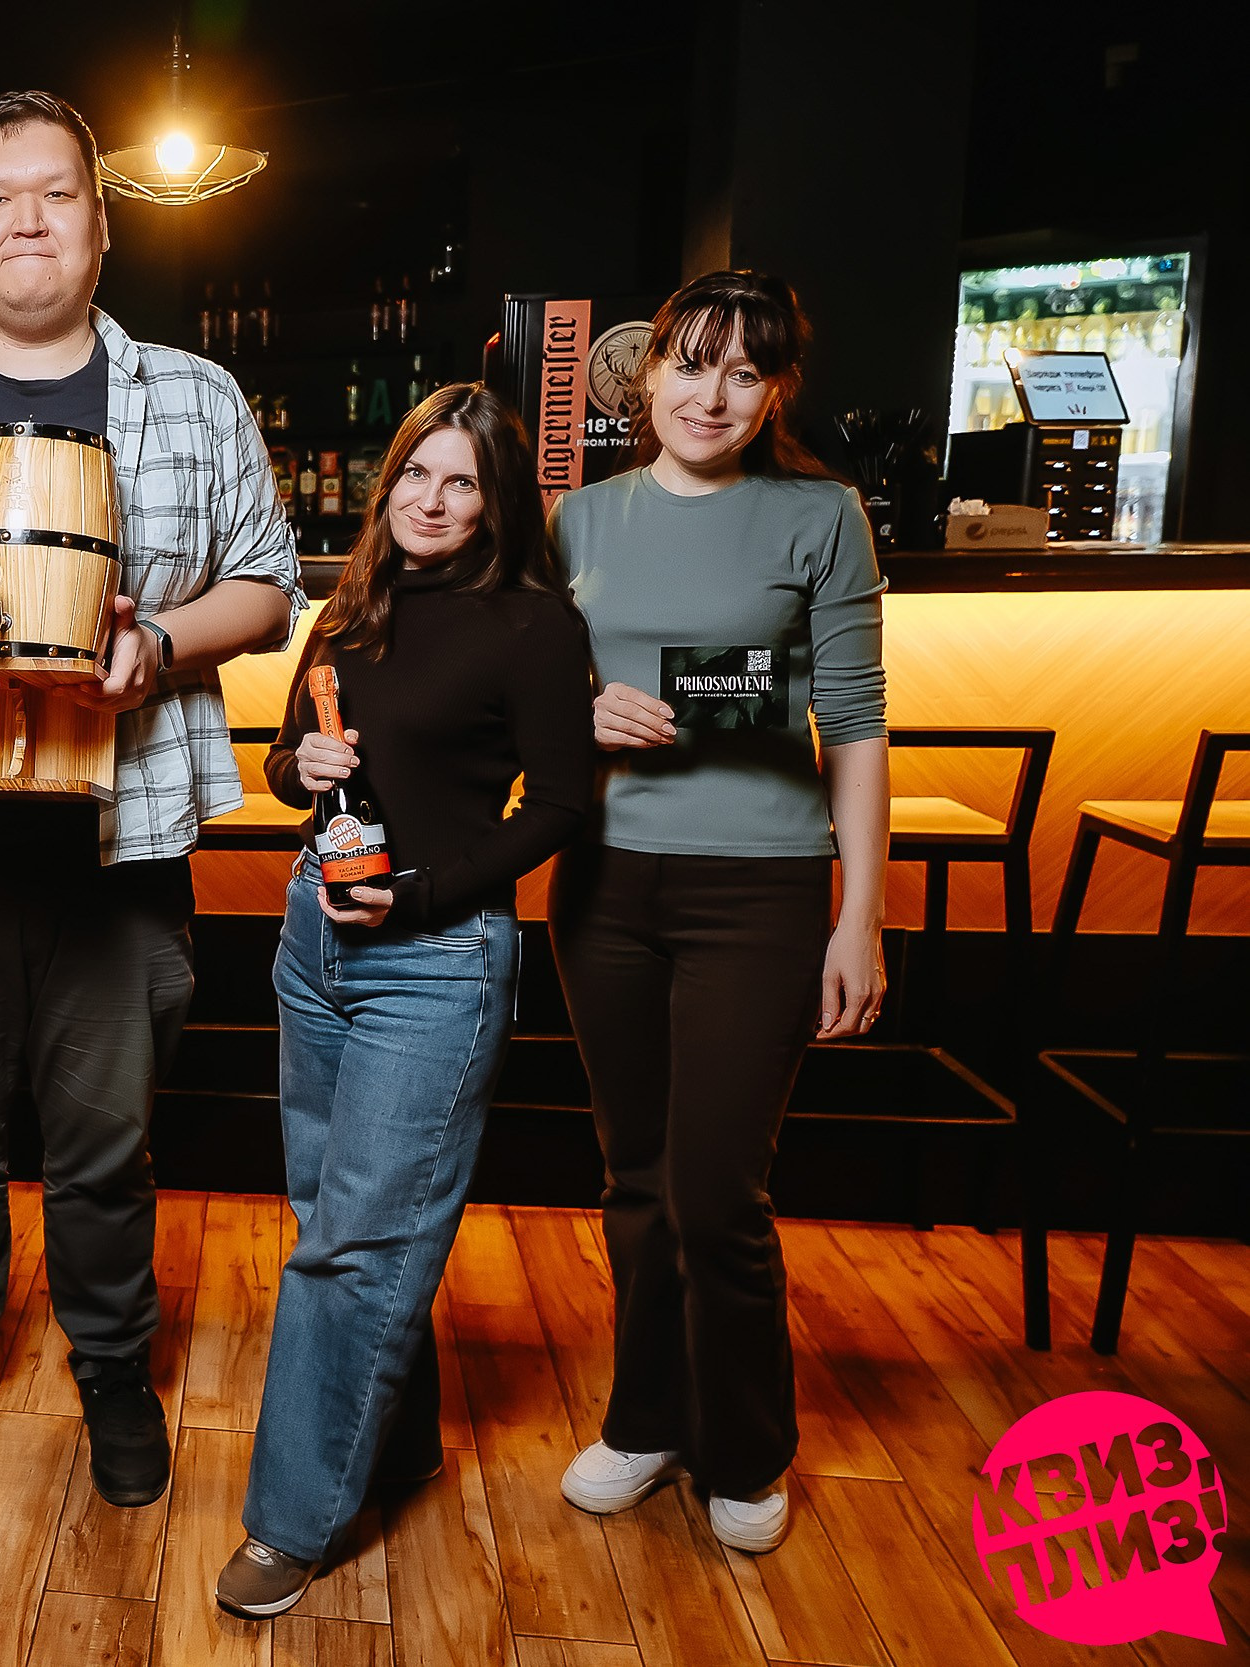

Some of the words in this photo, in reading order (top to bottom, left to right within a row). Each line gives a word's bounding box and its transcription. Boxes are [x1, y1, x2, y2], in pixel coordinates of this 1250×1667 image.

[576, 438, 607, 447] FROM
[675, 675, 773, 691] PRIKOSNOVENIE
[321, 851, 343, 863] SANTO
[345, 845, 381, 859] STEFANO
